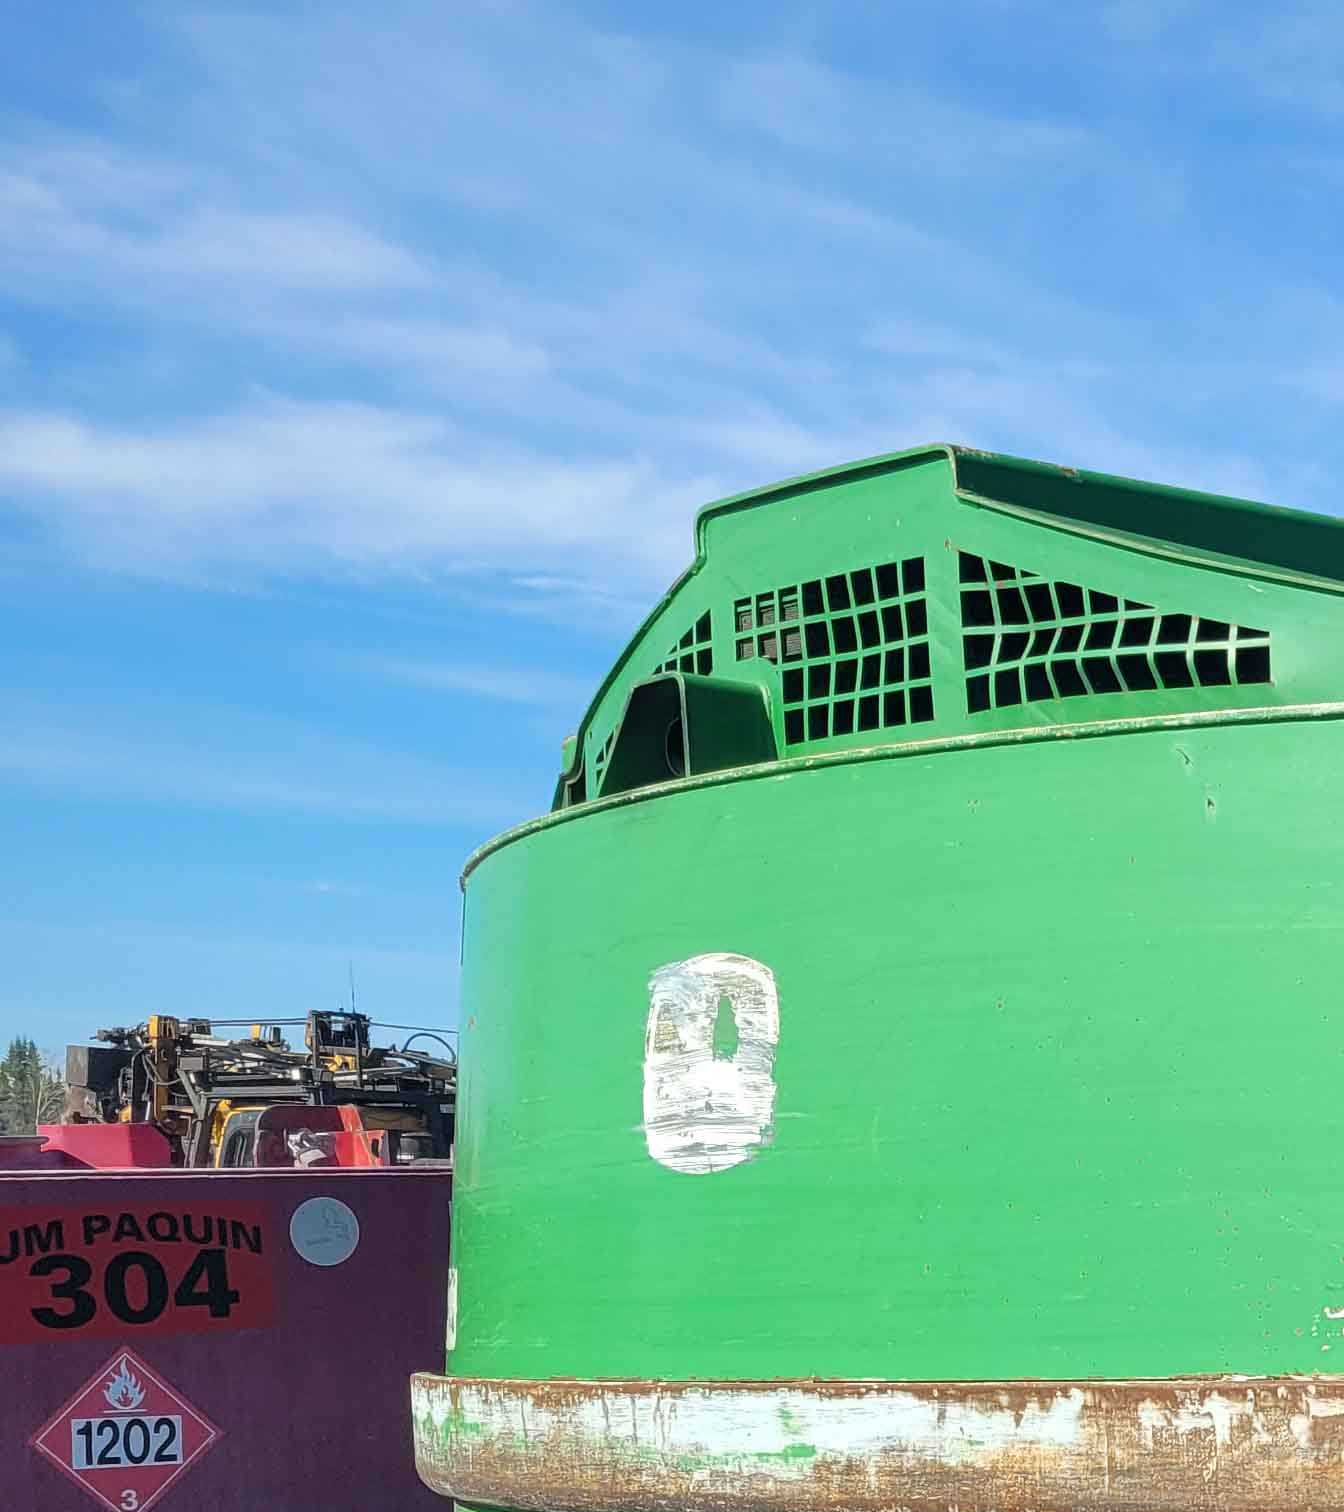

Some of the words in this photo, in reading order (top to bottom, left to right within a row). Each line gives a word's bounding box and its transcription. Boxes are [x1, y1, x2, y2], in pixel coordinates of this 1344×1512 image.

[82, 1211, 263, 1254] PAQUIN
[29, 1248, 240, 1329] 304
[76, 1417, 178, 1466] 1202
[120, 1489, 140, 1511] 3
